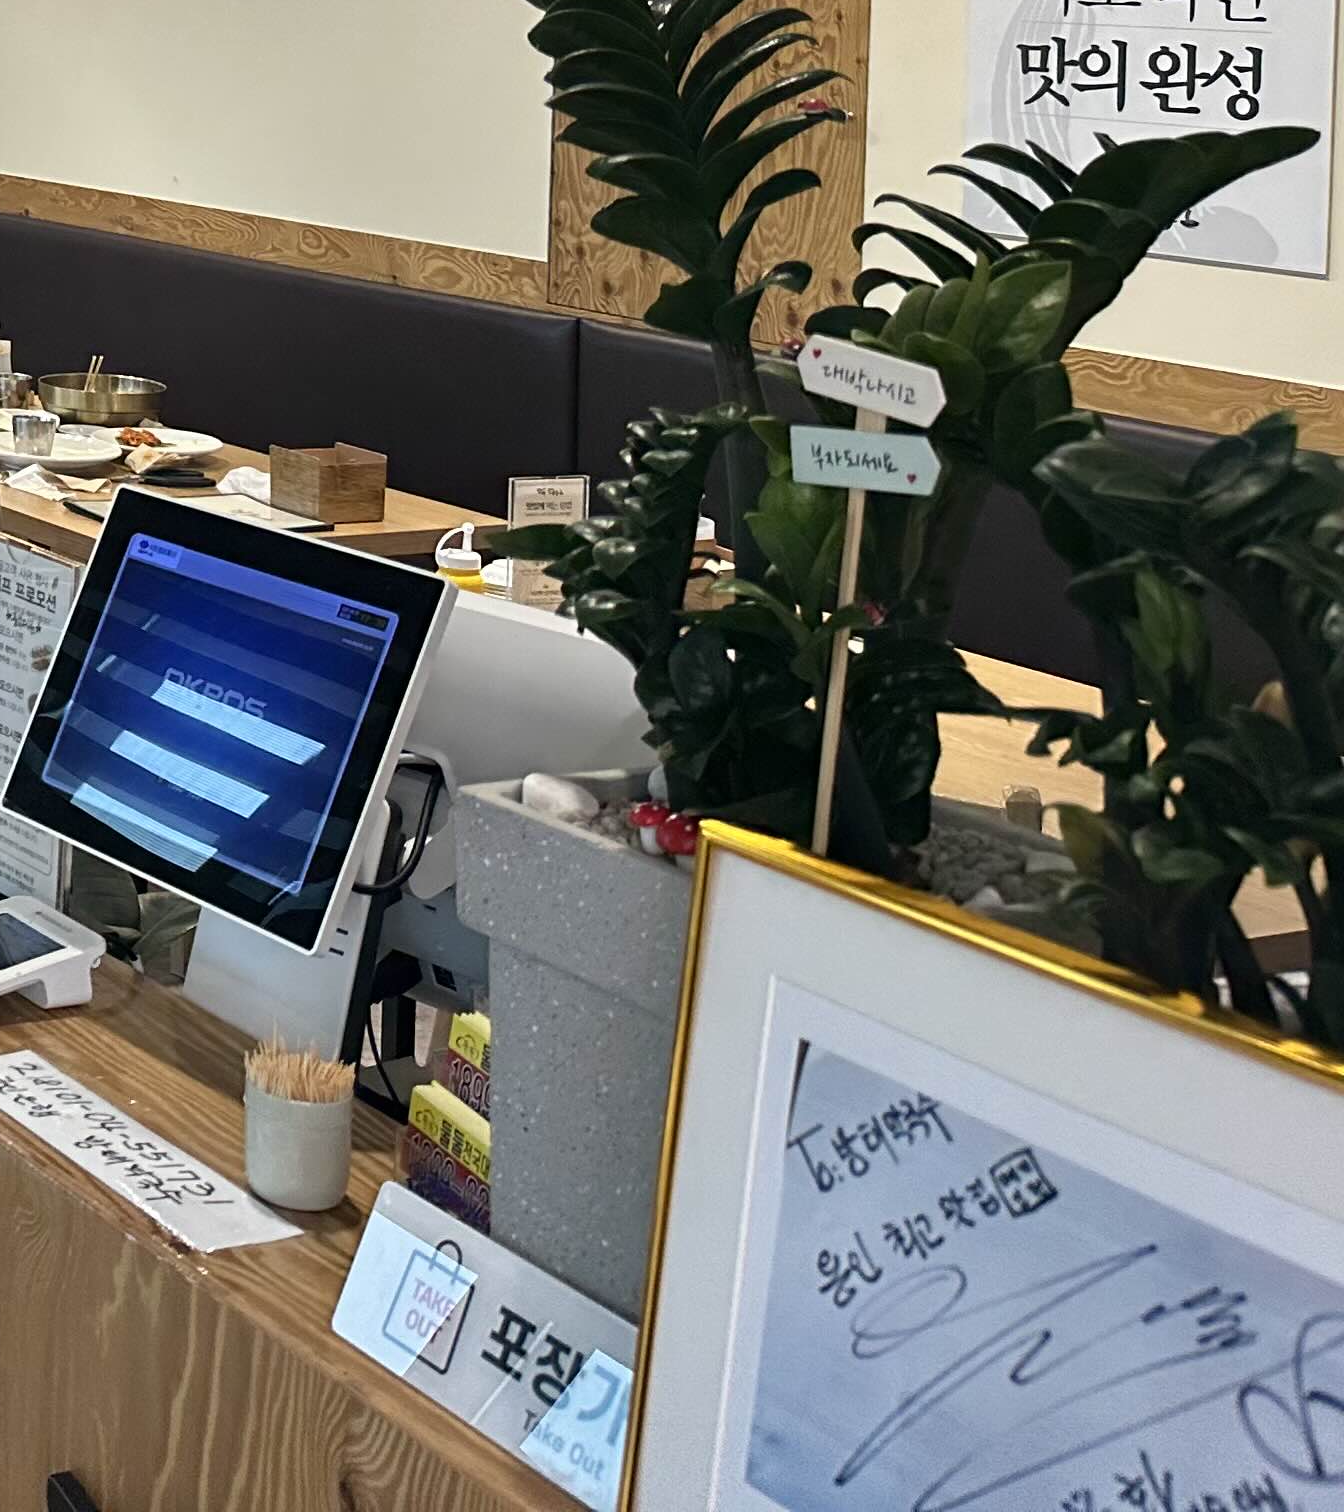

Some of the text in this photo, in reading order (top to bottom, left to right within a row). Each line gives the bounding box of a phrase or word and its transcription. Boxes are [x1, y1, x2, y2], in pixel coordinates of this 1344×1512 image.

[1016, 35, 1265, 121] 맛의 완성
[810, 442, 899, 473] 부자되세요
[14, 582, 57, 614] 프로모션
[569, 1442, 605, 1481] Out
